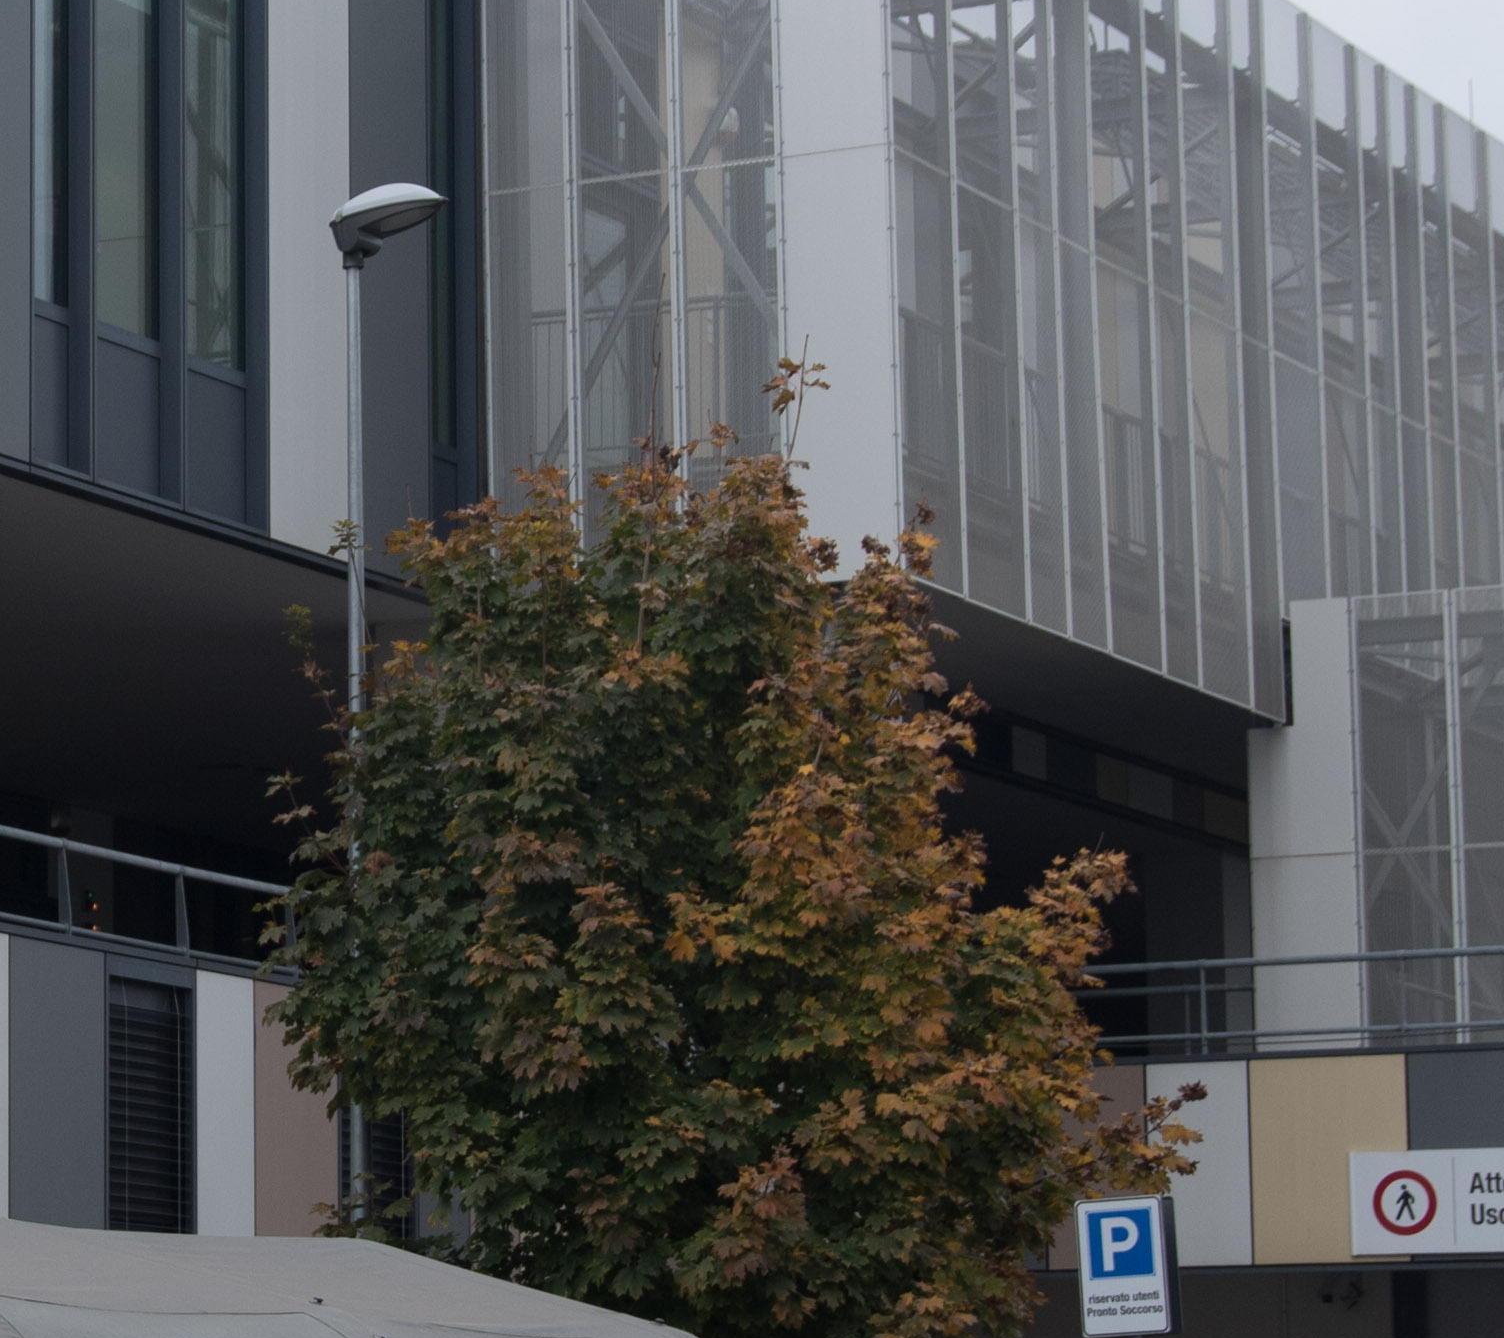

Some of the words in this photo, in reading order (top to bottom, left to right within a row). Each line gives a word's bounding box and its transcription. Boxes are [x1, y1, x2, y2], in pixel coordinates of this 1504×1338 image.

[1100, 1216, 1139, 1272] P
[1088, 1292, 1130, 1304] riservato
[1132, 1290, 1160, 1301] utenti
[1086, 1307, 1118, 1317] Pronto
[1119, 1304, 1164, 1315] Soccorso
